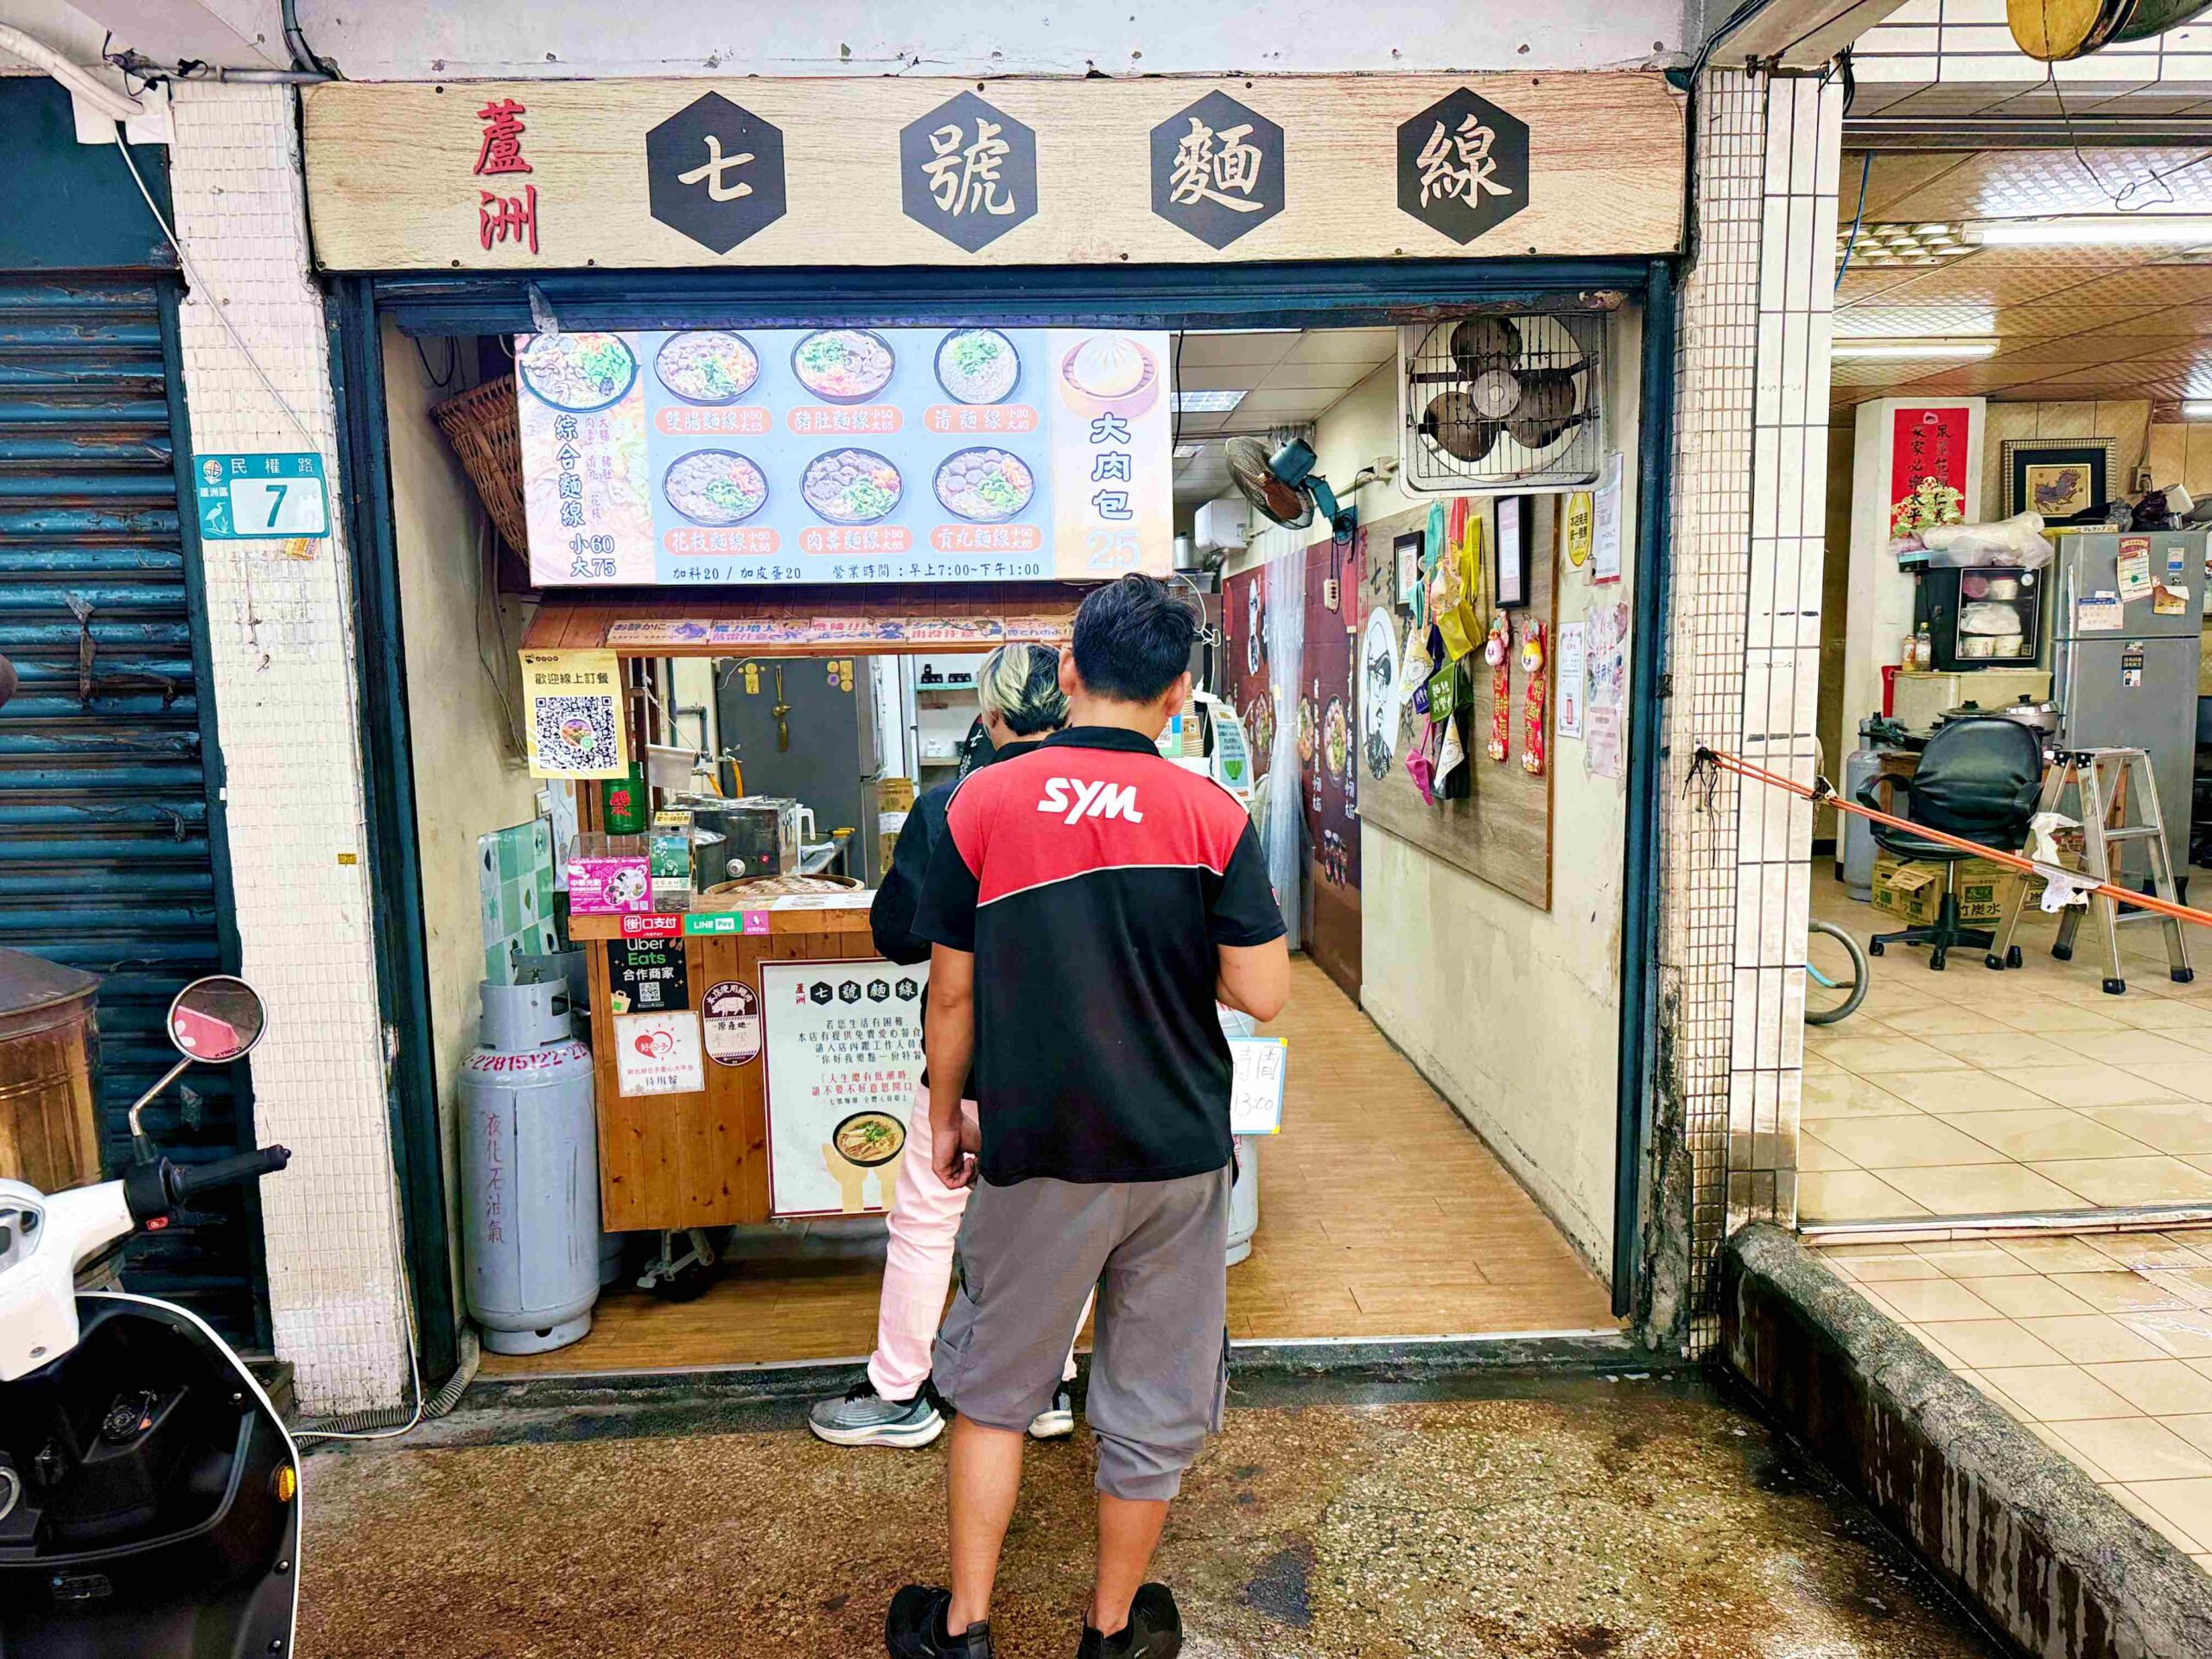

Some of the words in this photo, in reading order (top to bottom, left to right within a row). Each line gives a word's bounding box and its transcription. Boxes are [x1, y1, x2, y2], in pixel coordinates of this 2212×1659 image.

[677, 113, 1512, 218] 七號麵線
[474, 99, 538, 254] 蘆洲
[665, 410, 739, 431] 雙腸麵線
[795, 410, 869, 431] 豬肚麵線
[935, 409, 1001, 429] 清麵線
[231, 458, 314, 474] 民權路
[554, 415, 585, 528] 綜合麵線
[1090, 411, 1133, 520] 大肉包
[265, 485, 288, 528] 7
[569, 533, 615, 556] 小60
[671, 531, 747, 552] 花枝麵線
[807, 529, 880, 551] 肉羹麵線
[937, 527, 1009, 549] 貢丸麵線
[1087, 527, 1141, 570] 25
[570, 556, 617, 578] 大75
[535, 672, 609, 685] 歡迎線上訂餐
[1037, 778, 1144, 825] SYM
[624, 915, 677, 932] 街口支付
[694, 920, 714, 930] LINE
[717, 919, 733, 928] Pay
[626, 938, 664, 951] Uber
[628, 952, 666, 966] Eats
[622, 967, 675, 982] 合作商家
[815, 981, 916, 1000] 七號麵線
[215, 1046, 243, 1058] KYMCO
